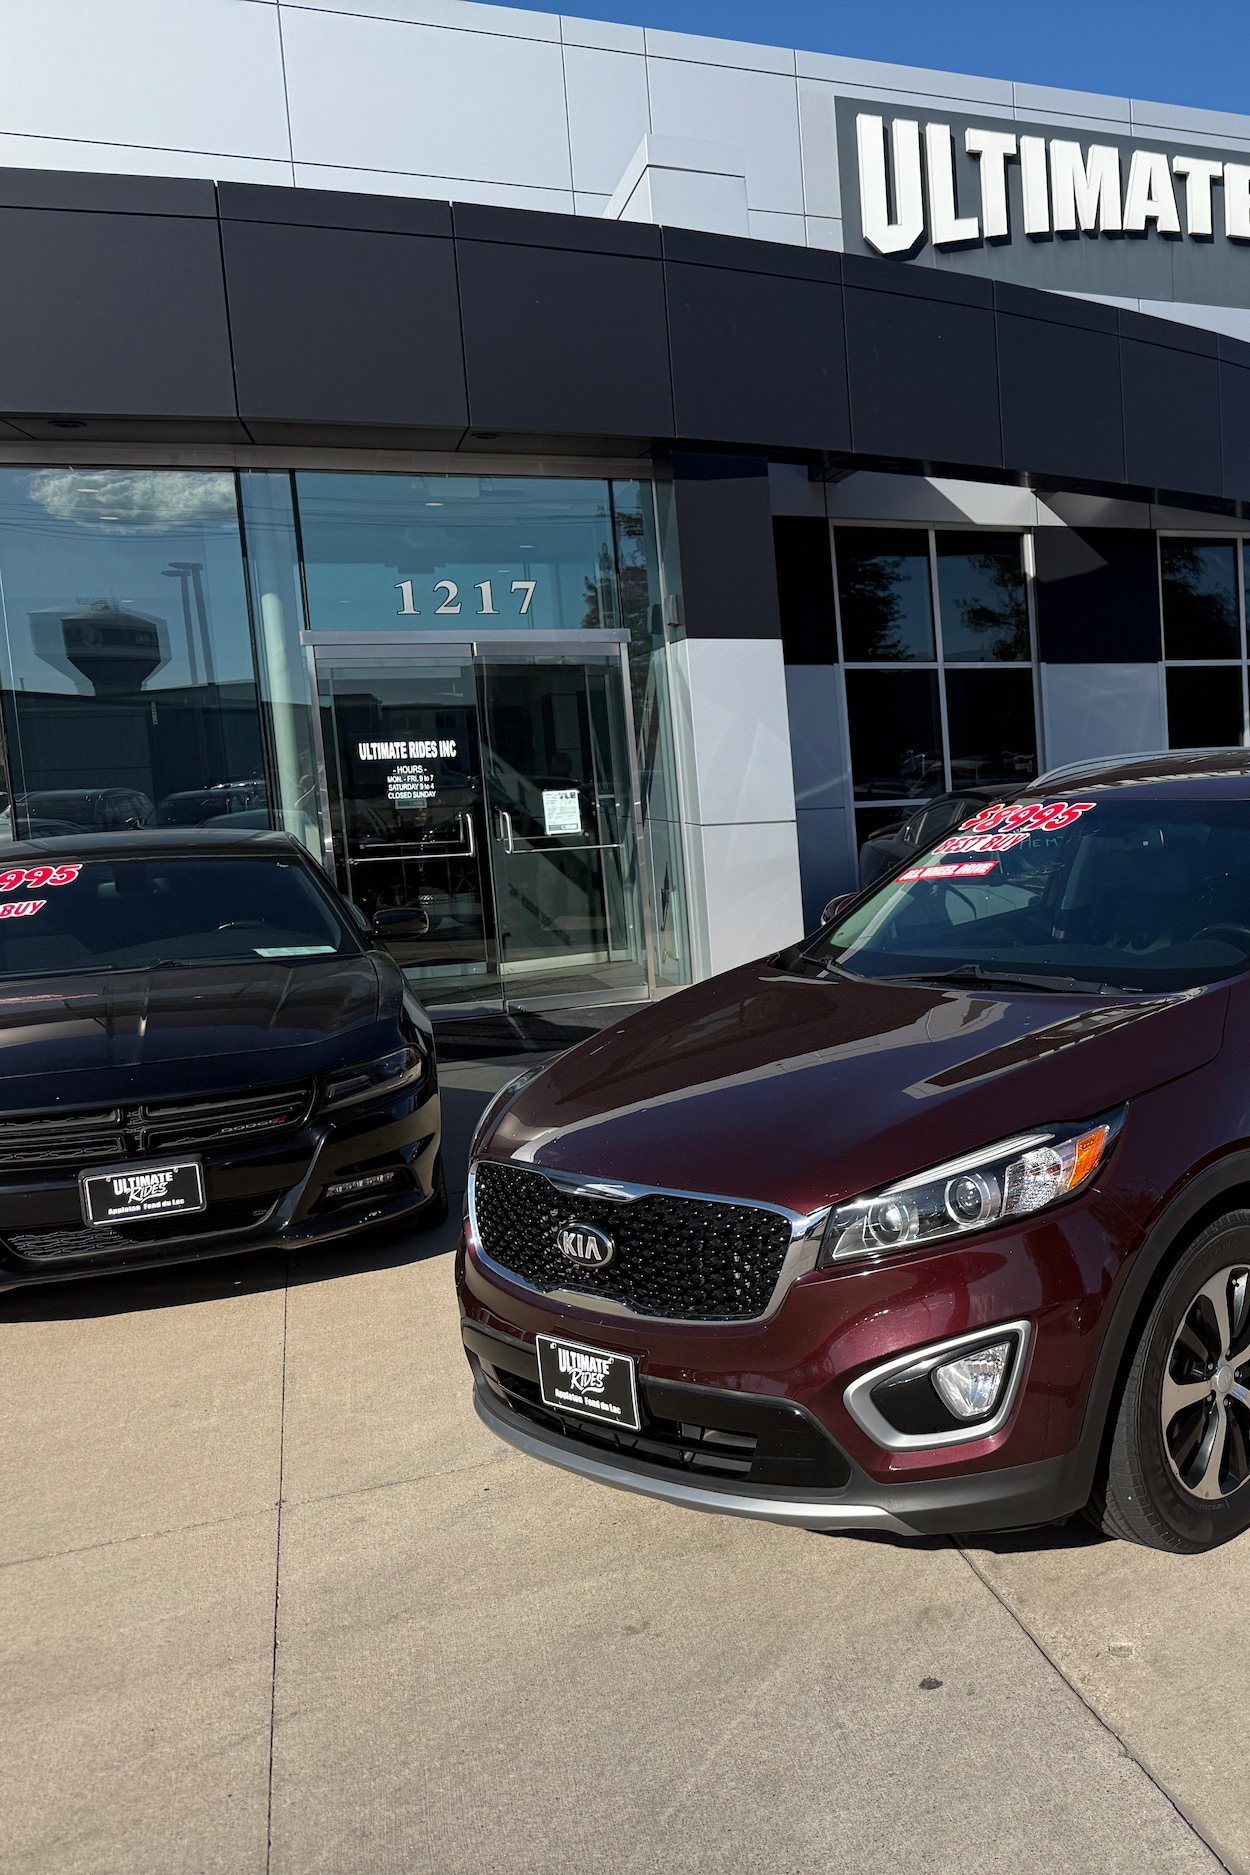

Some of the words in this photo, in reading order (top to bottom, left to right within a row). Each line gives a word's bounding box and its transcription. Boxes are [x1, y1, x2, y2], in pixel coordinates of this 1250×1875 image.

[394, 580, 537, 616] 1217
[358, 741, 408, 760] ULTIMATE
[408, 740, 438, 759] RIDES
[439, 739, 457, 758] INC
[397, 765, 423, 774] HOURS
[387, 791, 412, 800] CLOSED
[412, 790, 437, 799] SUNDAY
[388, 783, 419, 792] SATURDAY
[931, 834, 984, 856] BEST
[979, 833, 1031, 853] BUY
[0, 900, 47, 919] BUY
[113, 1171, 174, 1196] ULTIMATE
[107, 1204, 141, 1216] Appleton
[143, 1201, 161, 1212] Fond
[162, 1200, 172, 1208] du
[562, 1230, 602, 1261] KIA
[558, 1347, 611, 1375] ULTIMATE
